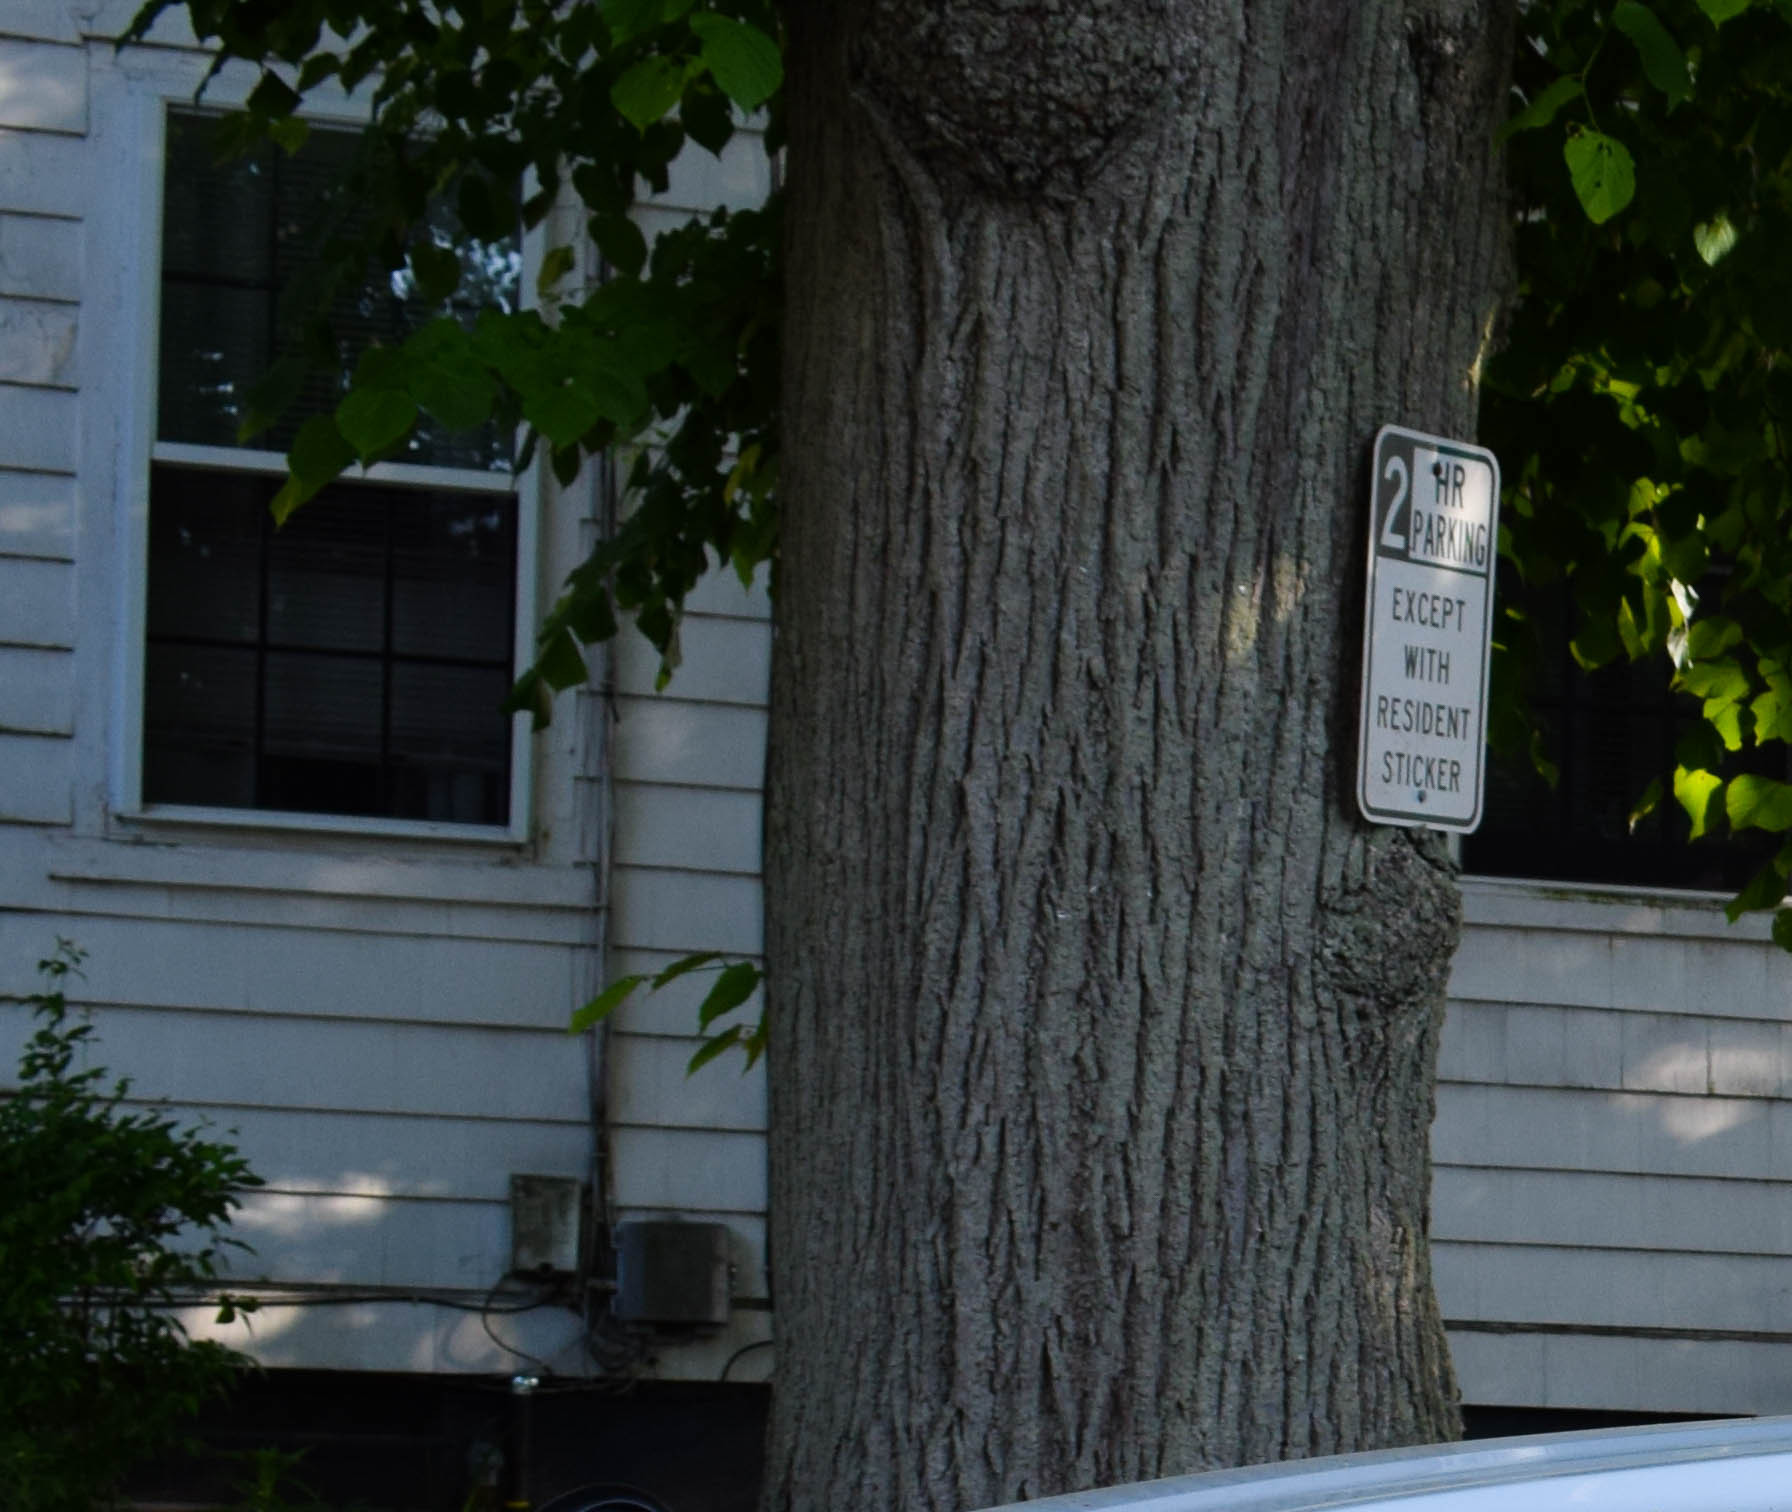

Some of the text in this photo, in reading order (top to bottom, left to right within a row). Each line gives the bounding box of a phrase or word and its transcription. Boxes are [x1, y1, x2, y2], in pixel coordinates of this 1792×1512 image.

[1380, 456, 1466, 550] 2 HR
[1412, 510, 1487, 567] PARKING
[1391, 587, 1466, 633] EXCEPT
[1404, 645, 1450, 684] WITH
[1376, 694, 1471, 741] RESIDENT
[1381, 751, 1461, 793] STICKER
